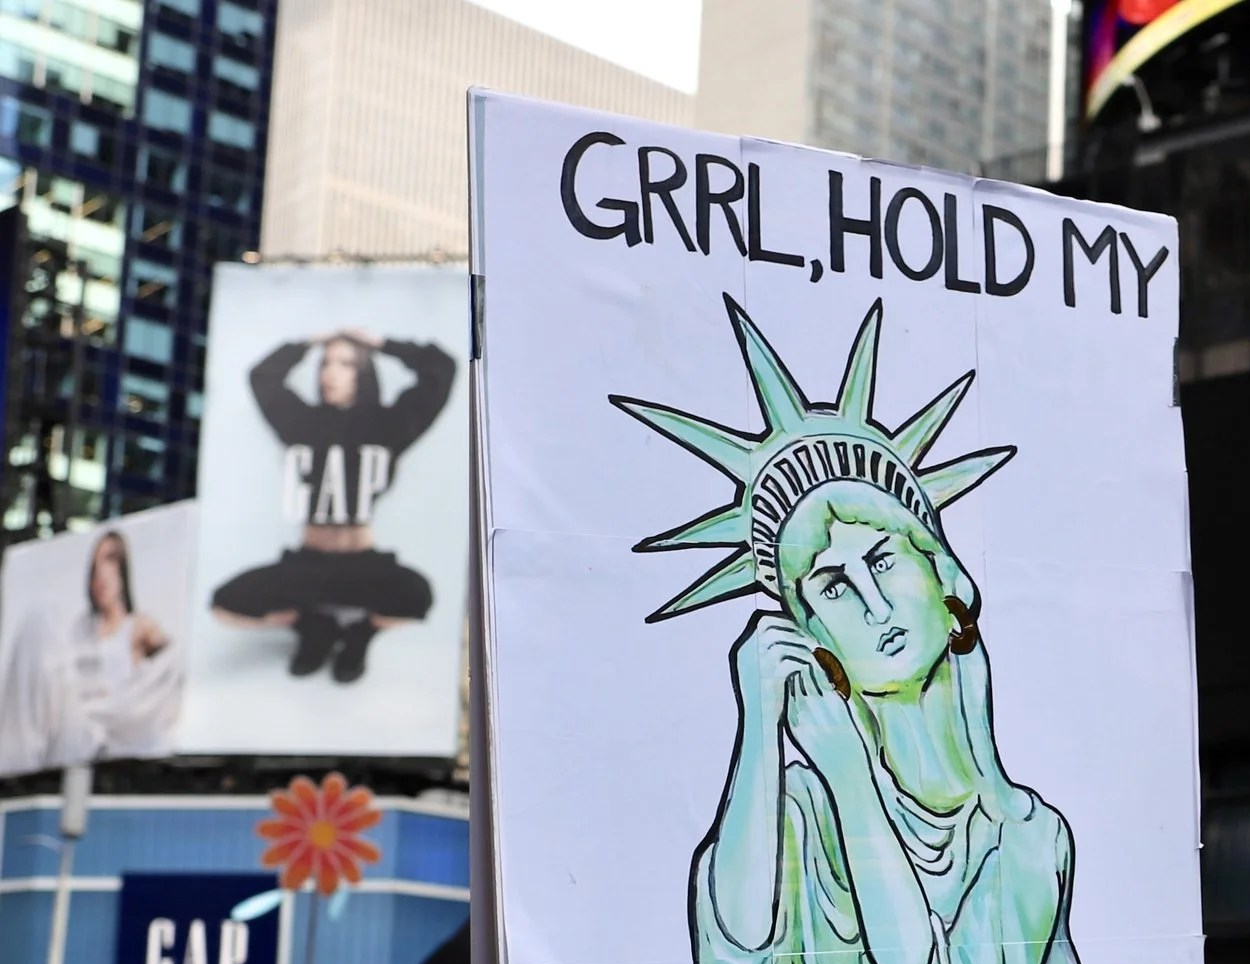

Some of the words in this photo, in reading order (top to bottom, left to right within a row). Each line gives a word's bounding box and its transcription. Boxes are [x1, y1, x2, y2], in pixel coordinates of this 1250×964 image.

[561, 131, 824, 283] GRRL,
[828, 169, 1034, 297] HOLD
[1063, 217, 1169, 318] MY
[282, 442, 391, 525] GAP
